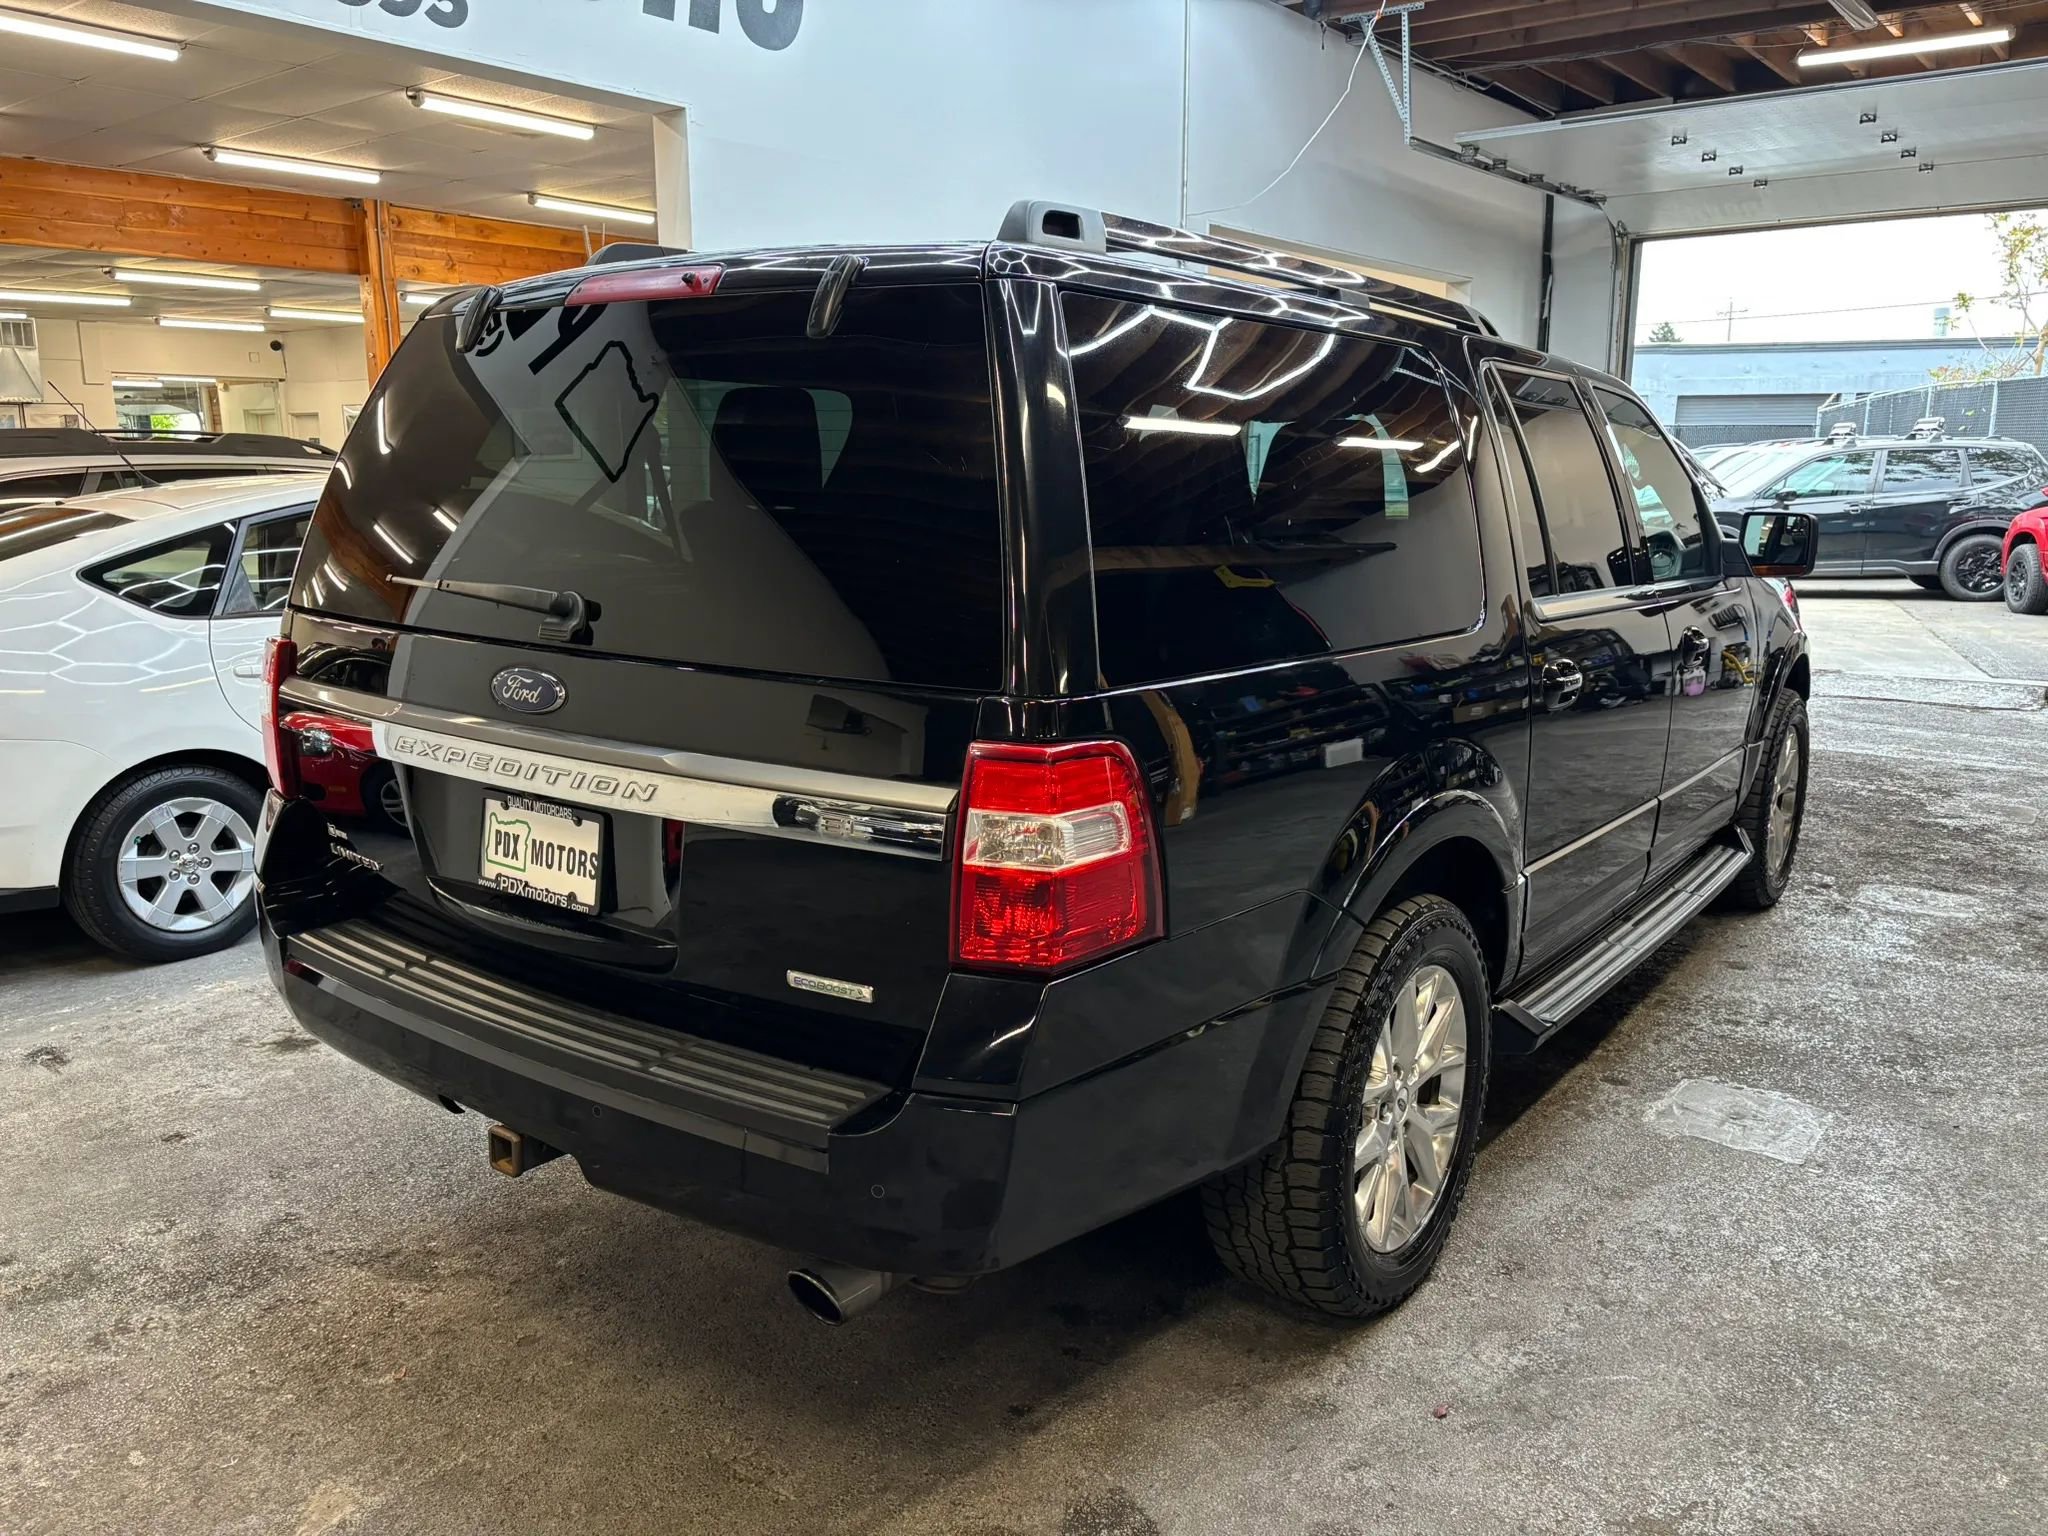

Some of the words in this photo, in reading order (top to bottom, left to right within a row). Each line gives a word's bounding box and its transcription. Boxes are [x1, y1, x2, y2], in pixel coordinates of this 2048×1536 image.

[502, 674, 542, 704] Ford
[394, 735, 660, 802] EXPEDITION
[507, 795, 532, 811] QUALITY
[532, 800, 573, 820] MOTORCARS
[494, 829, 521, 861] PDX
[531, 839, 599, 880] MOTORS
[478, 877, 589, 913] www.PDXmotors.com
